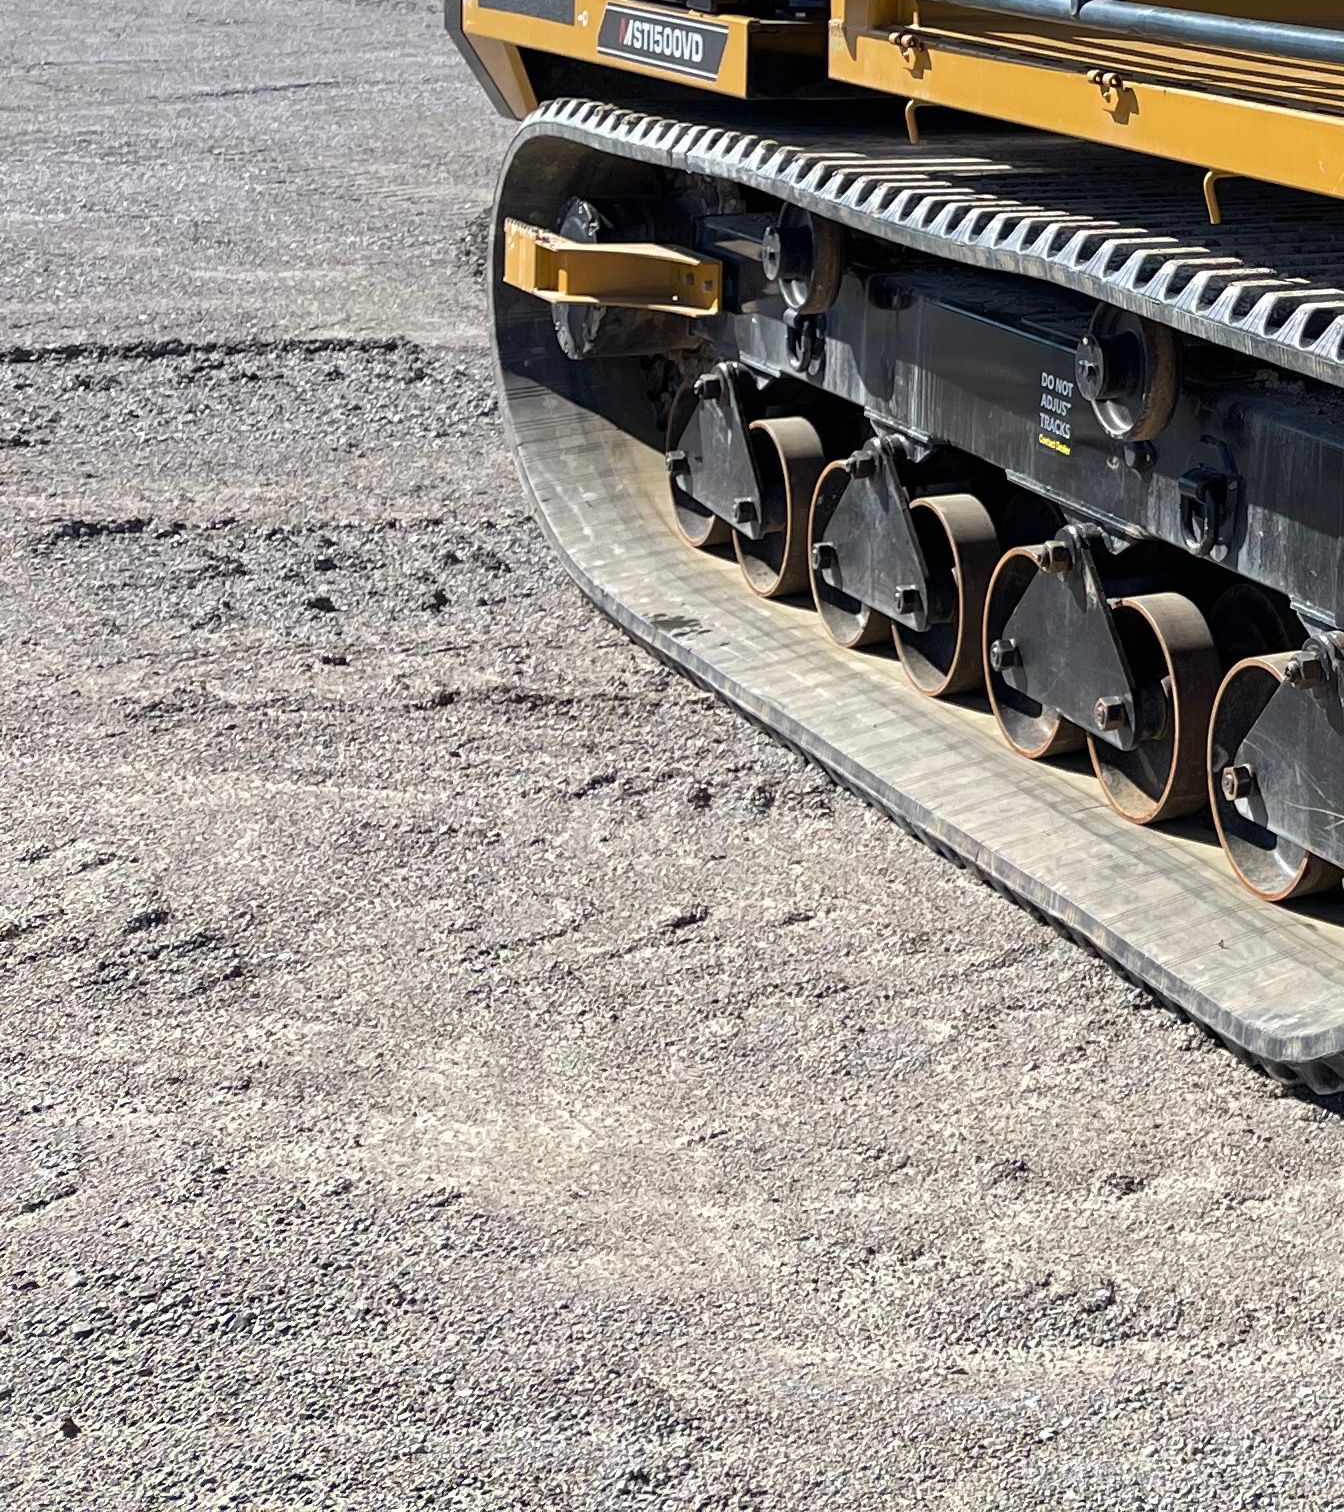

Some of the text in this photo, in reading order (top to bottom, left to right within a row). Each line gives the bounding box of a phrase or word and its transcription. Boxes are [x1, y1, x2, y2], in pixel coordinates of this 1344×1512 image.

[1041, 372, 1074, 397] DO NOT
[1039, 412, 1071, 439] TRACKS
